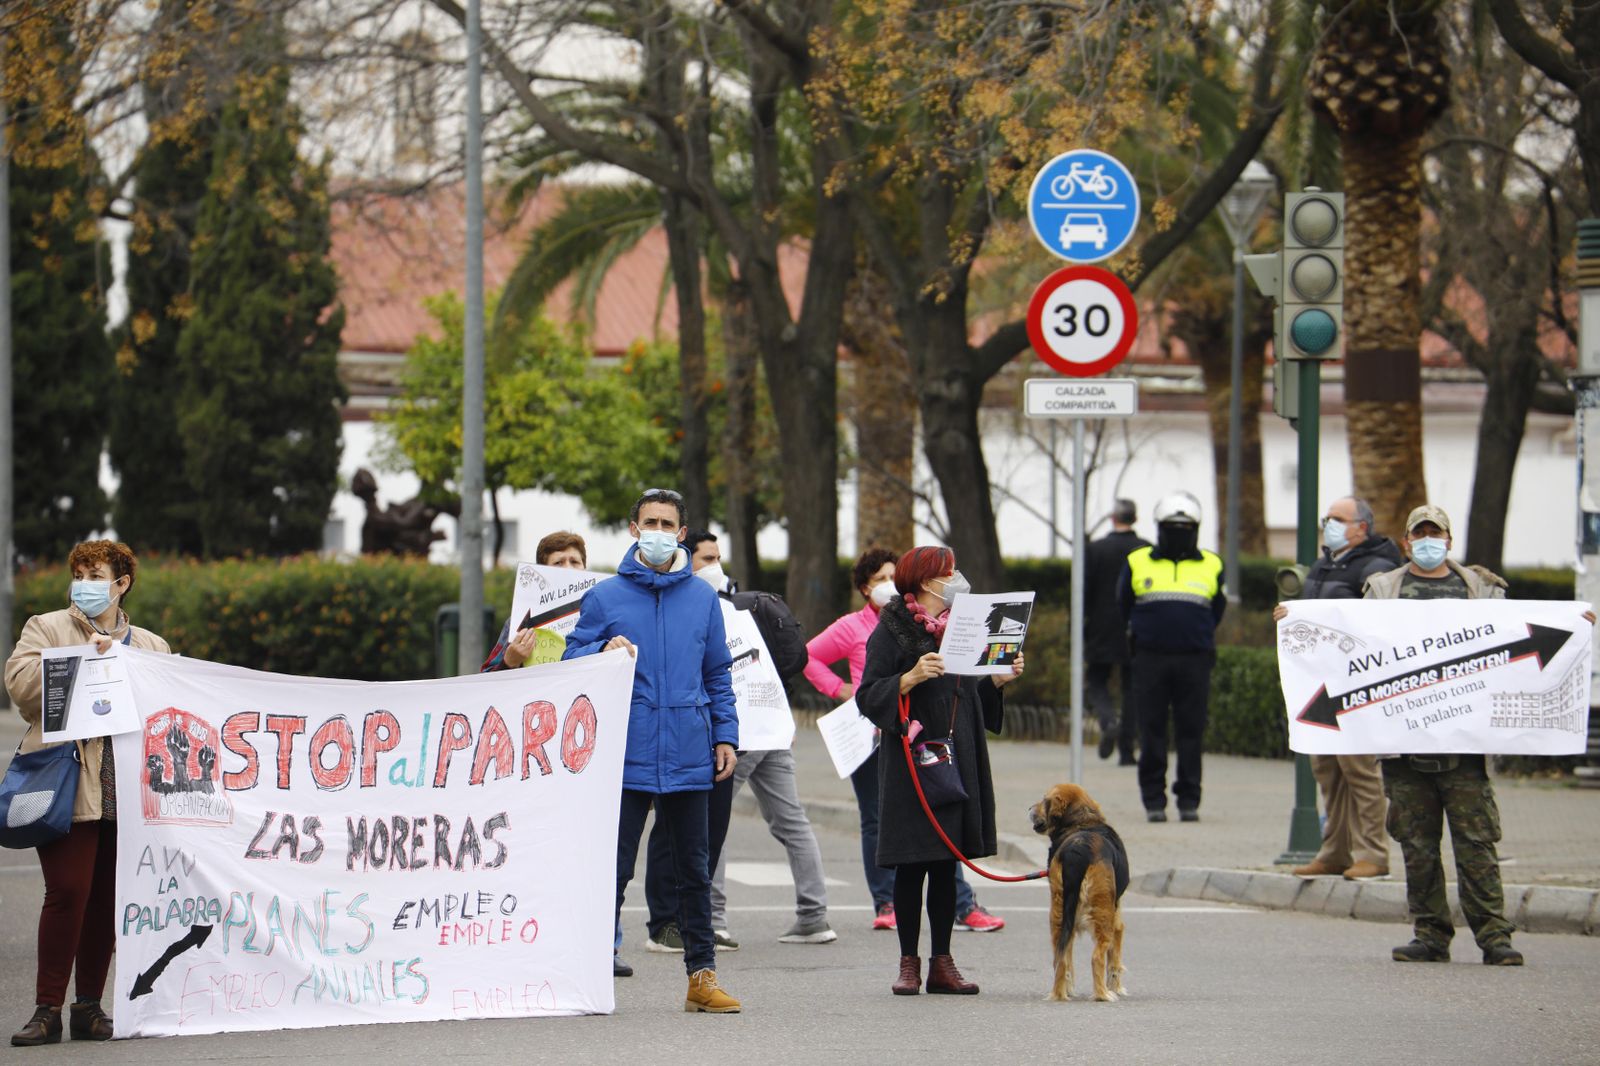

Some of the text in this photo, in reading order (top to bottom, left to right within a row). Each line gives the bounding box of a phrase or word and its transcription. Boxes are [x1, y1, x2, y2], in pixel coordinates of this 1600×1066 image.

[1053, 304, 1110, 337] 30
[1045, 401, 1116, 410] COMPARTIDA
[1055, 387, 1105, 396] CALZADA
[557, 588, 567, 599] La
[568, 577, 596, 594] Palabra
[1348, 623, 1495, 676] AVV. La Palabra
[1342, 650, 1510, 711] LAS MORERAS ¡EXISTEN!
[1382, 679, 1486, 718] Un barrio toma
[1405, 703, 1473, 730] la palabra
[221, 693, 598, 792] STOP al PARO
[244, 810, 512, 872] LAS MORERAS
[158, 876, 179, 895] LA
[123, 895, 222, 936] PALABRA
[222, 888, 375, 960] PLANES
[392, 889, 518, 931] EMPLEO
[438, 916, 539, 946] EMPLEO
[179, 961, 286, 1027] EMPLEO
[293, 956, 430, 1006] ANUALES
[452, 979, 558, 1015] EMPLEO
